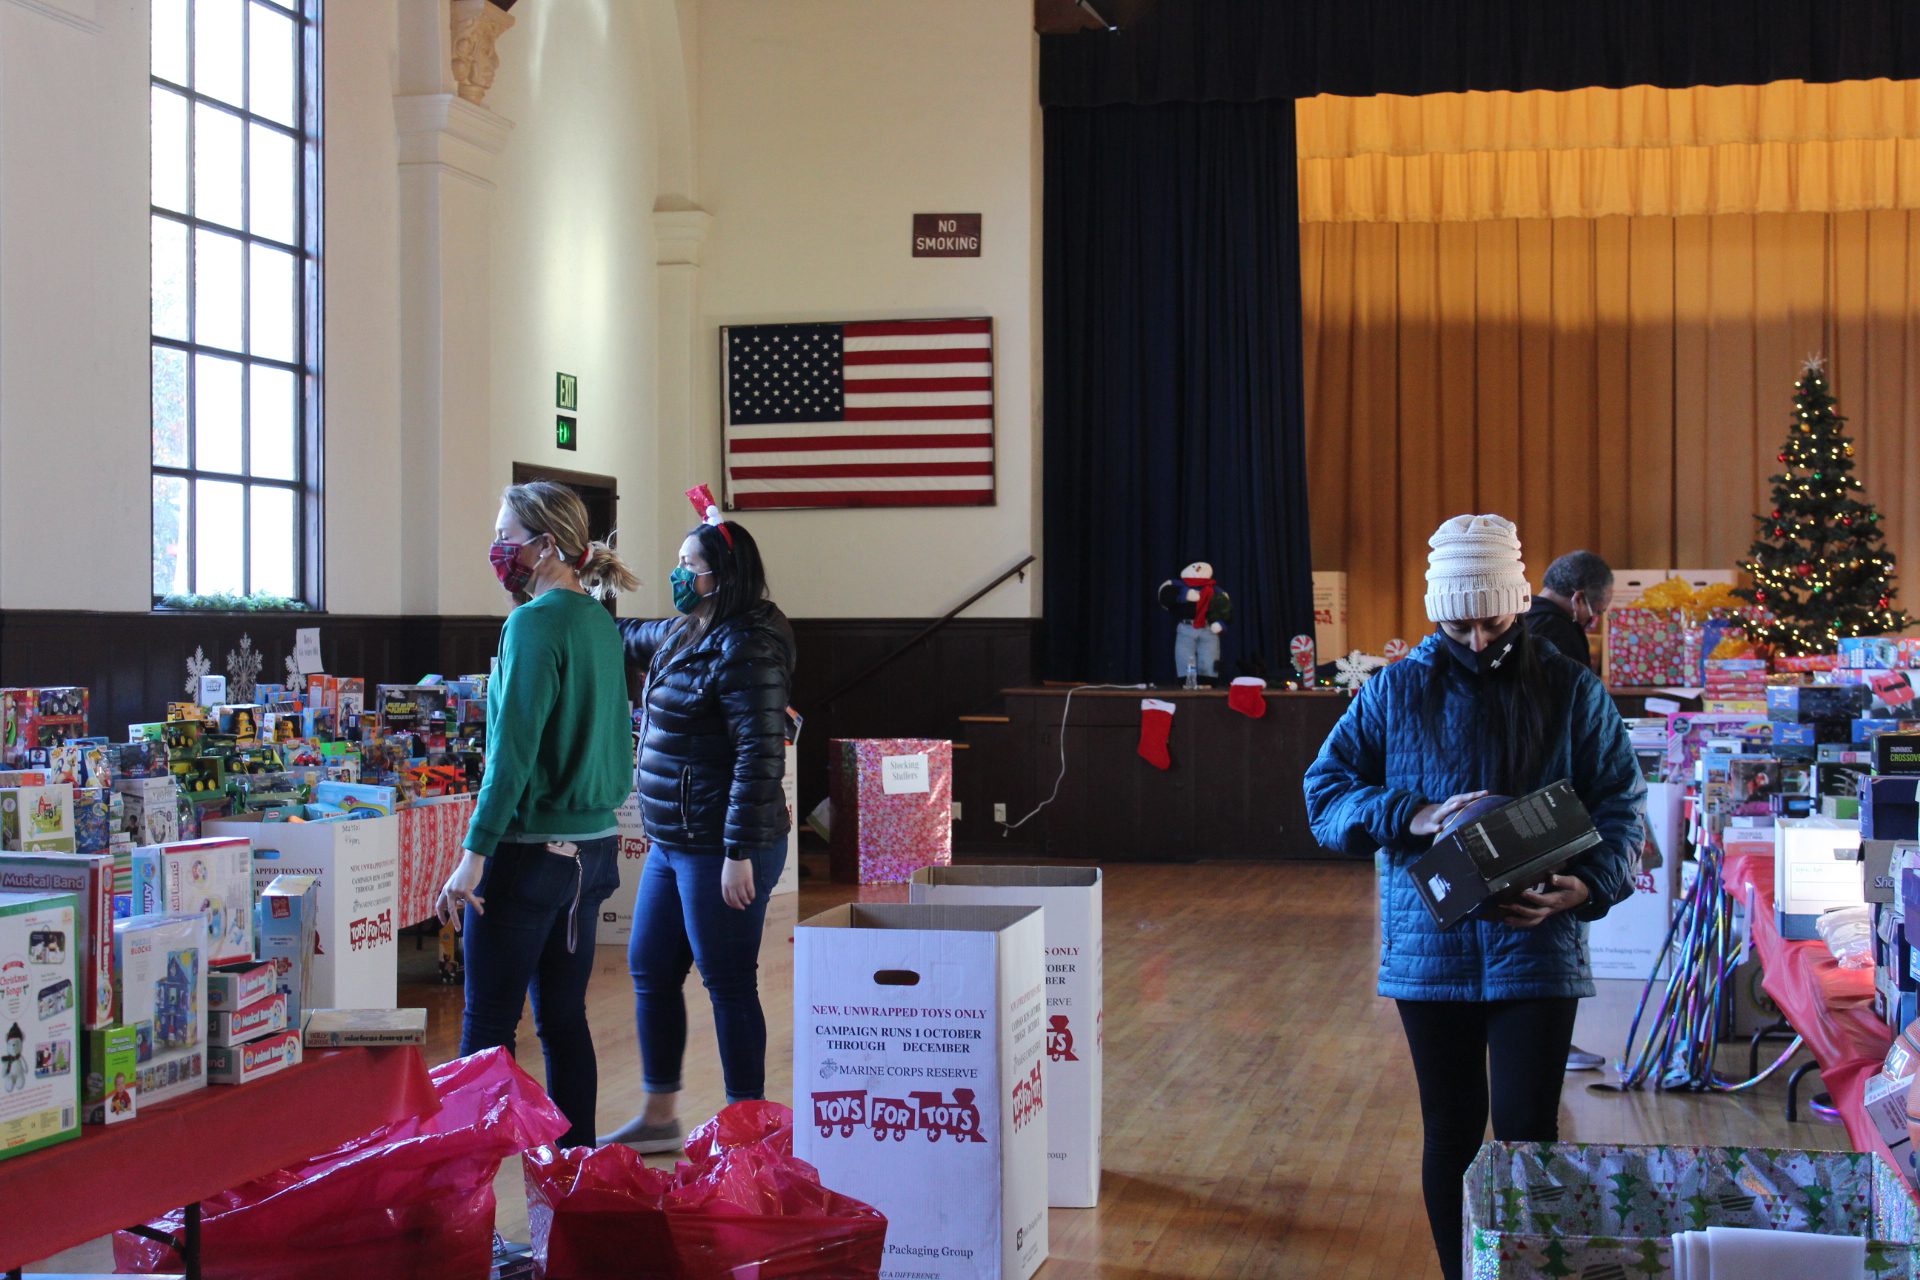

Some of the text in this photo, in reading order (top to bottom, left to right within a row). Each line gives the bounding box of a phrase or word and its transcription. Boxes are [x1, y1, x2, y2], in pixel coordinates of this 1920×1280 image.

[938, 220, 957, 233] NO
[916, 237, 978, 250] SMOKING
[560, 375, 575, 409] EXIT
[890, 760, 920, 770] Stocking
[892, 771, 918, 780] Stuffers
[625, 838, 643, 852] FOR
[280, 867, 301, 875] TOYS
[301, 867, 324, 875] ONLY
[3, 872, 85, 891] Musical Band
[351, 924, 366, 940] TOYS
[1051, 947, 1080, 956] ONLY
[812, 1005, 987, 1019] NEW, UNWRAPPED TOYS ONLY
[815, 1025, 982, 1039] CAMPAIGN RUNS 1 OCTOBER
[826, 1040, 970, 1053] THROUGH DECEMBER
[839, 1065, 978, 1079] MARINE CORPS RESERVE
[816, 1097, 973, 1131] TOYS FOR TOTS
[889, 1244, 974, 1259] Packaging Group
[894, 1271, 940, 1280] DIFFERENCE
